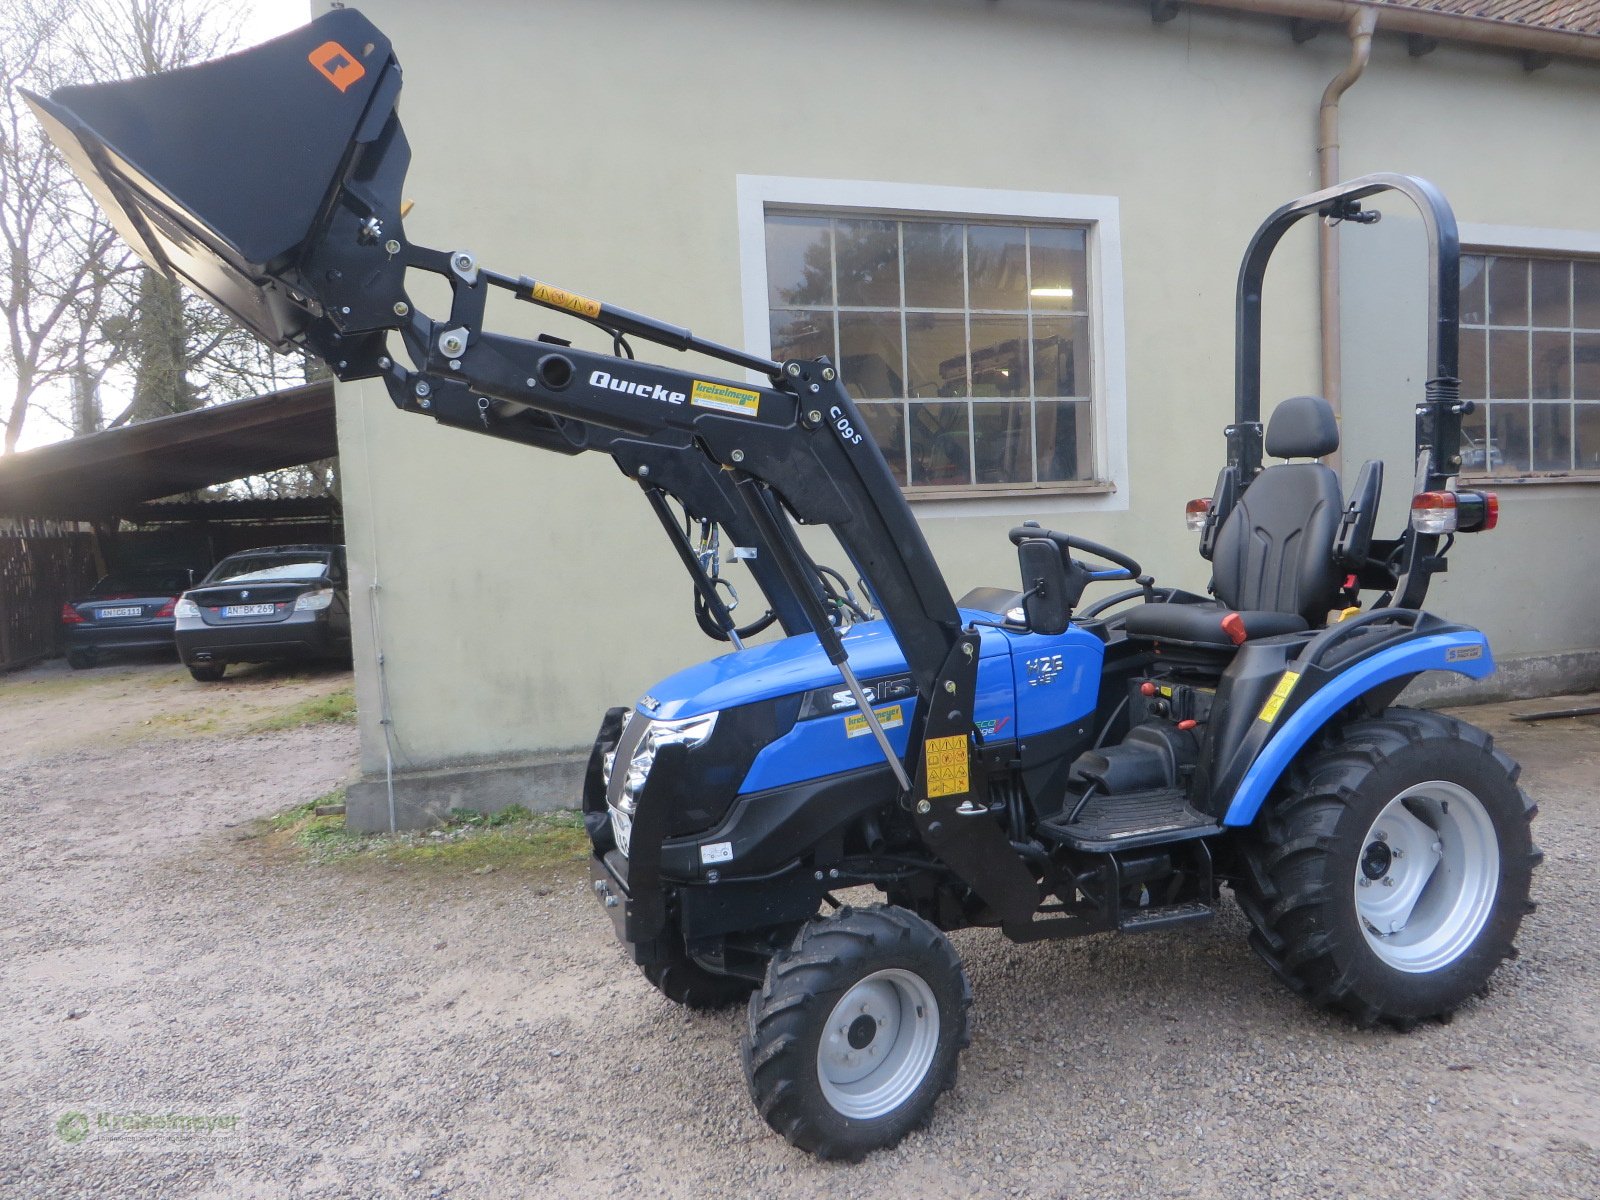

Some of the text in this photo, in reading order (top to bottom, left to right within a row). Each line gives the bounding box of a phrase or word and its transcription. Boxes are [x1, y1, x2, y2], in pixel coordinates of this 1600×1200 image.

[589, 370, 686, 405] Quicke
[227, 606, 238, 614] AN
[257, 604, 273, 613] 269
